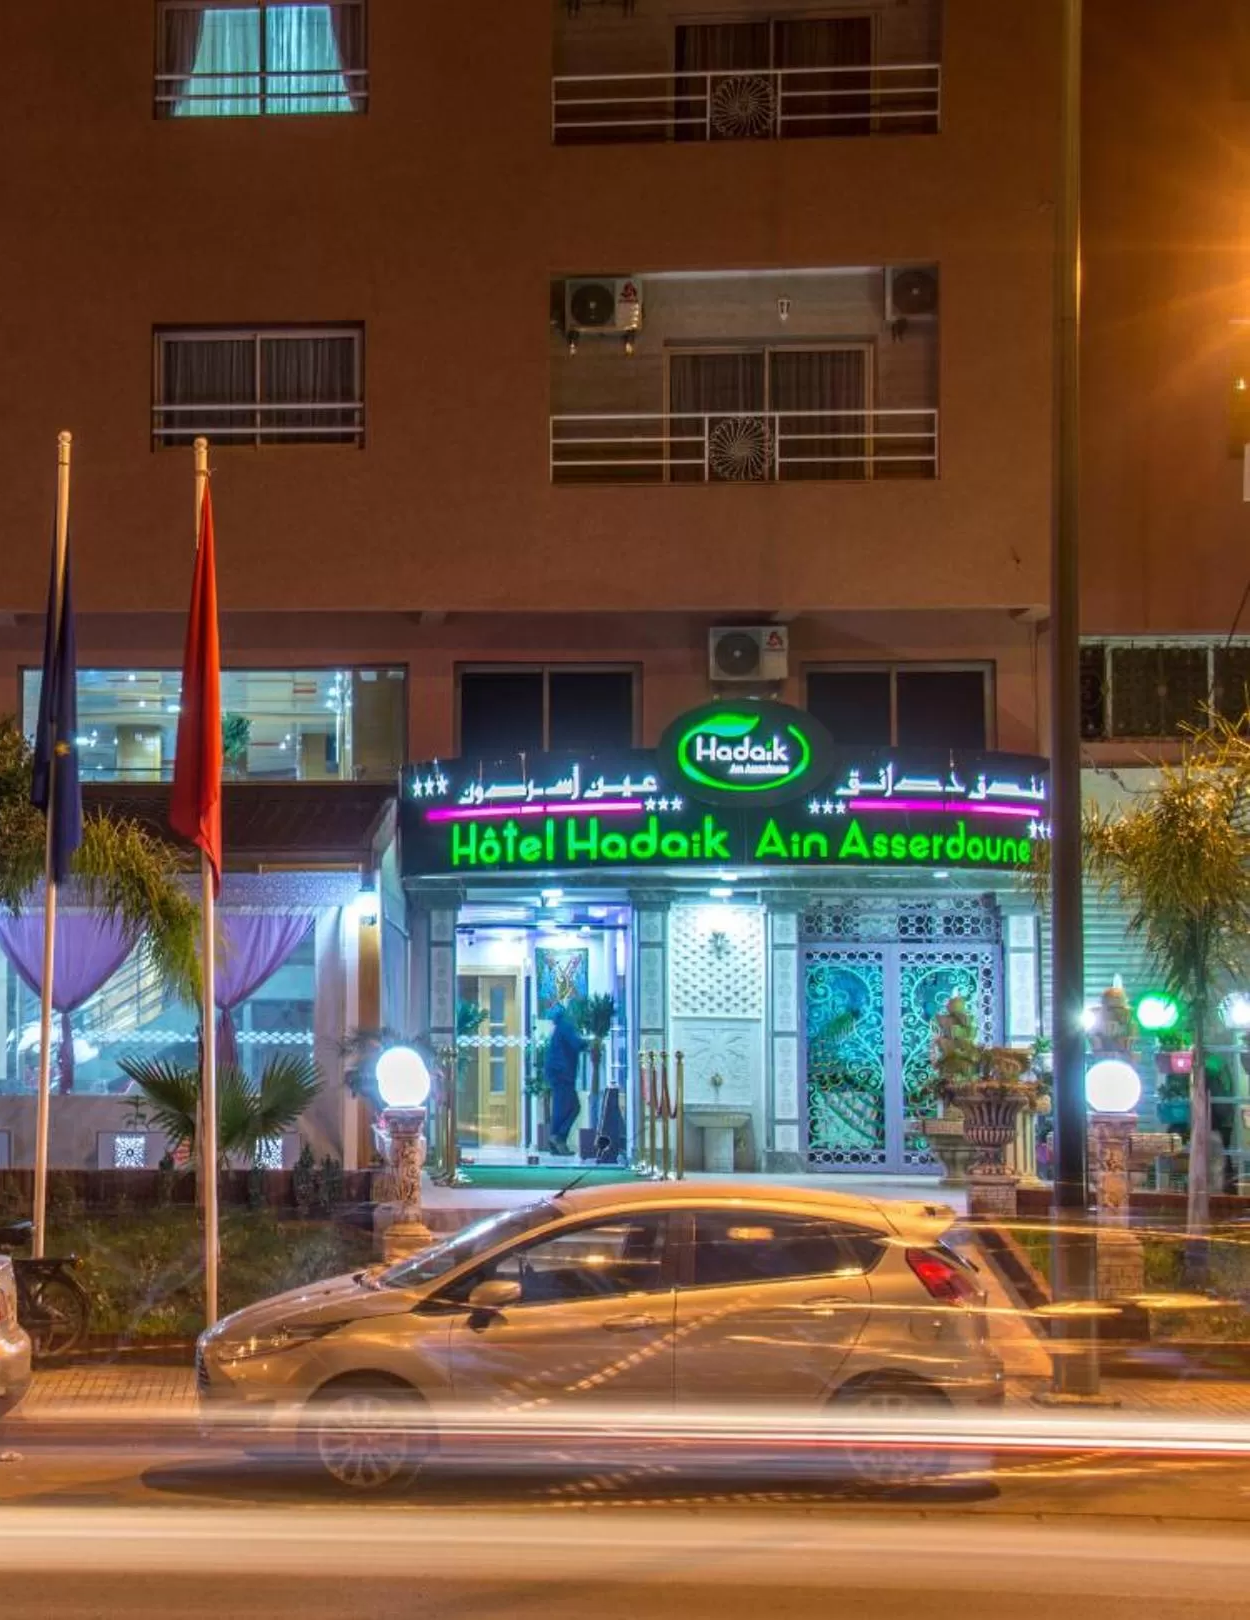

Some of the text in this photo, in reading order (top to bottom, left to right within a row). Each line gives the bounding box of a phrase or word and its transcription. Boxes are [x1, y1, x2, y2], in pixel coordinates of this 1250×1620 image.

[696, 735, 789, 762] Hadaik
[451, 814, 1032, 866] Hôtel Hadaik Ain Asserdoune
